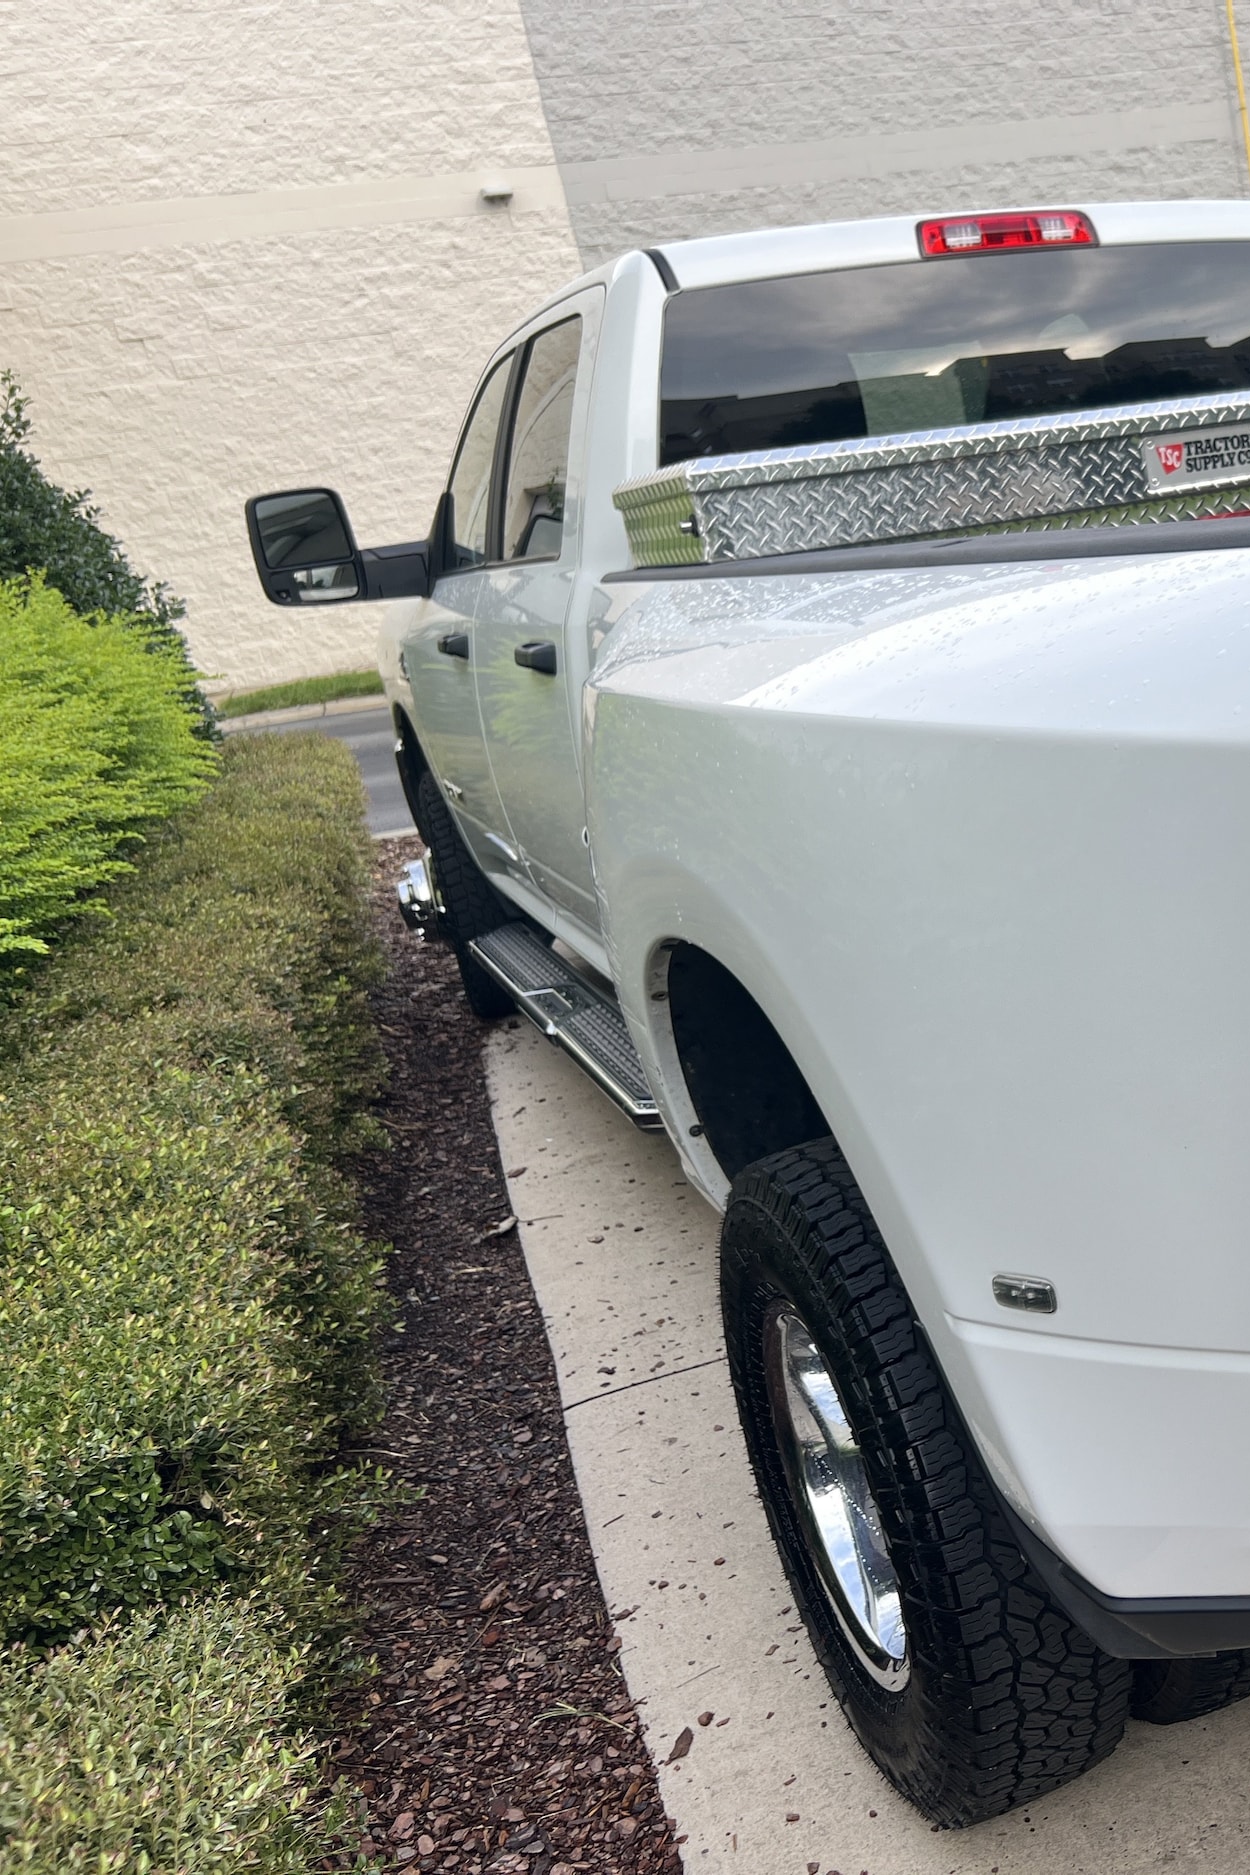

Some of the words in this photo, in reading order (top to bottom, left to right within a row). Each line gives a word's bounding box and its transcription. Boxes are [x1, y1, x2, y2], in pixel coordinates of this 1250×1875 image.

[1184, 434, 1250, 456] TRACTOR
[1158, 446, 1180, 468] TSC
[1185, 451, 1237, 473] SUPPLY
